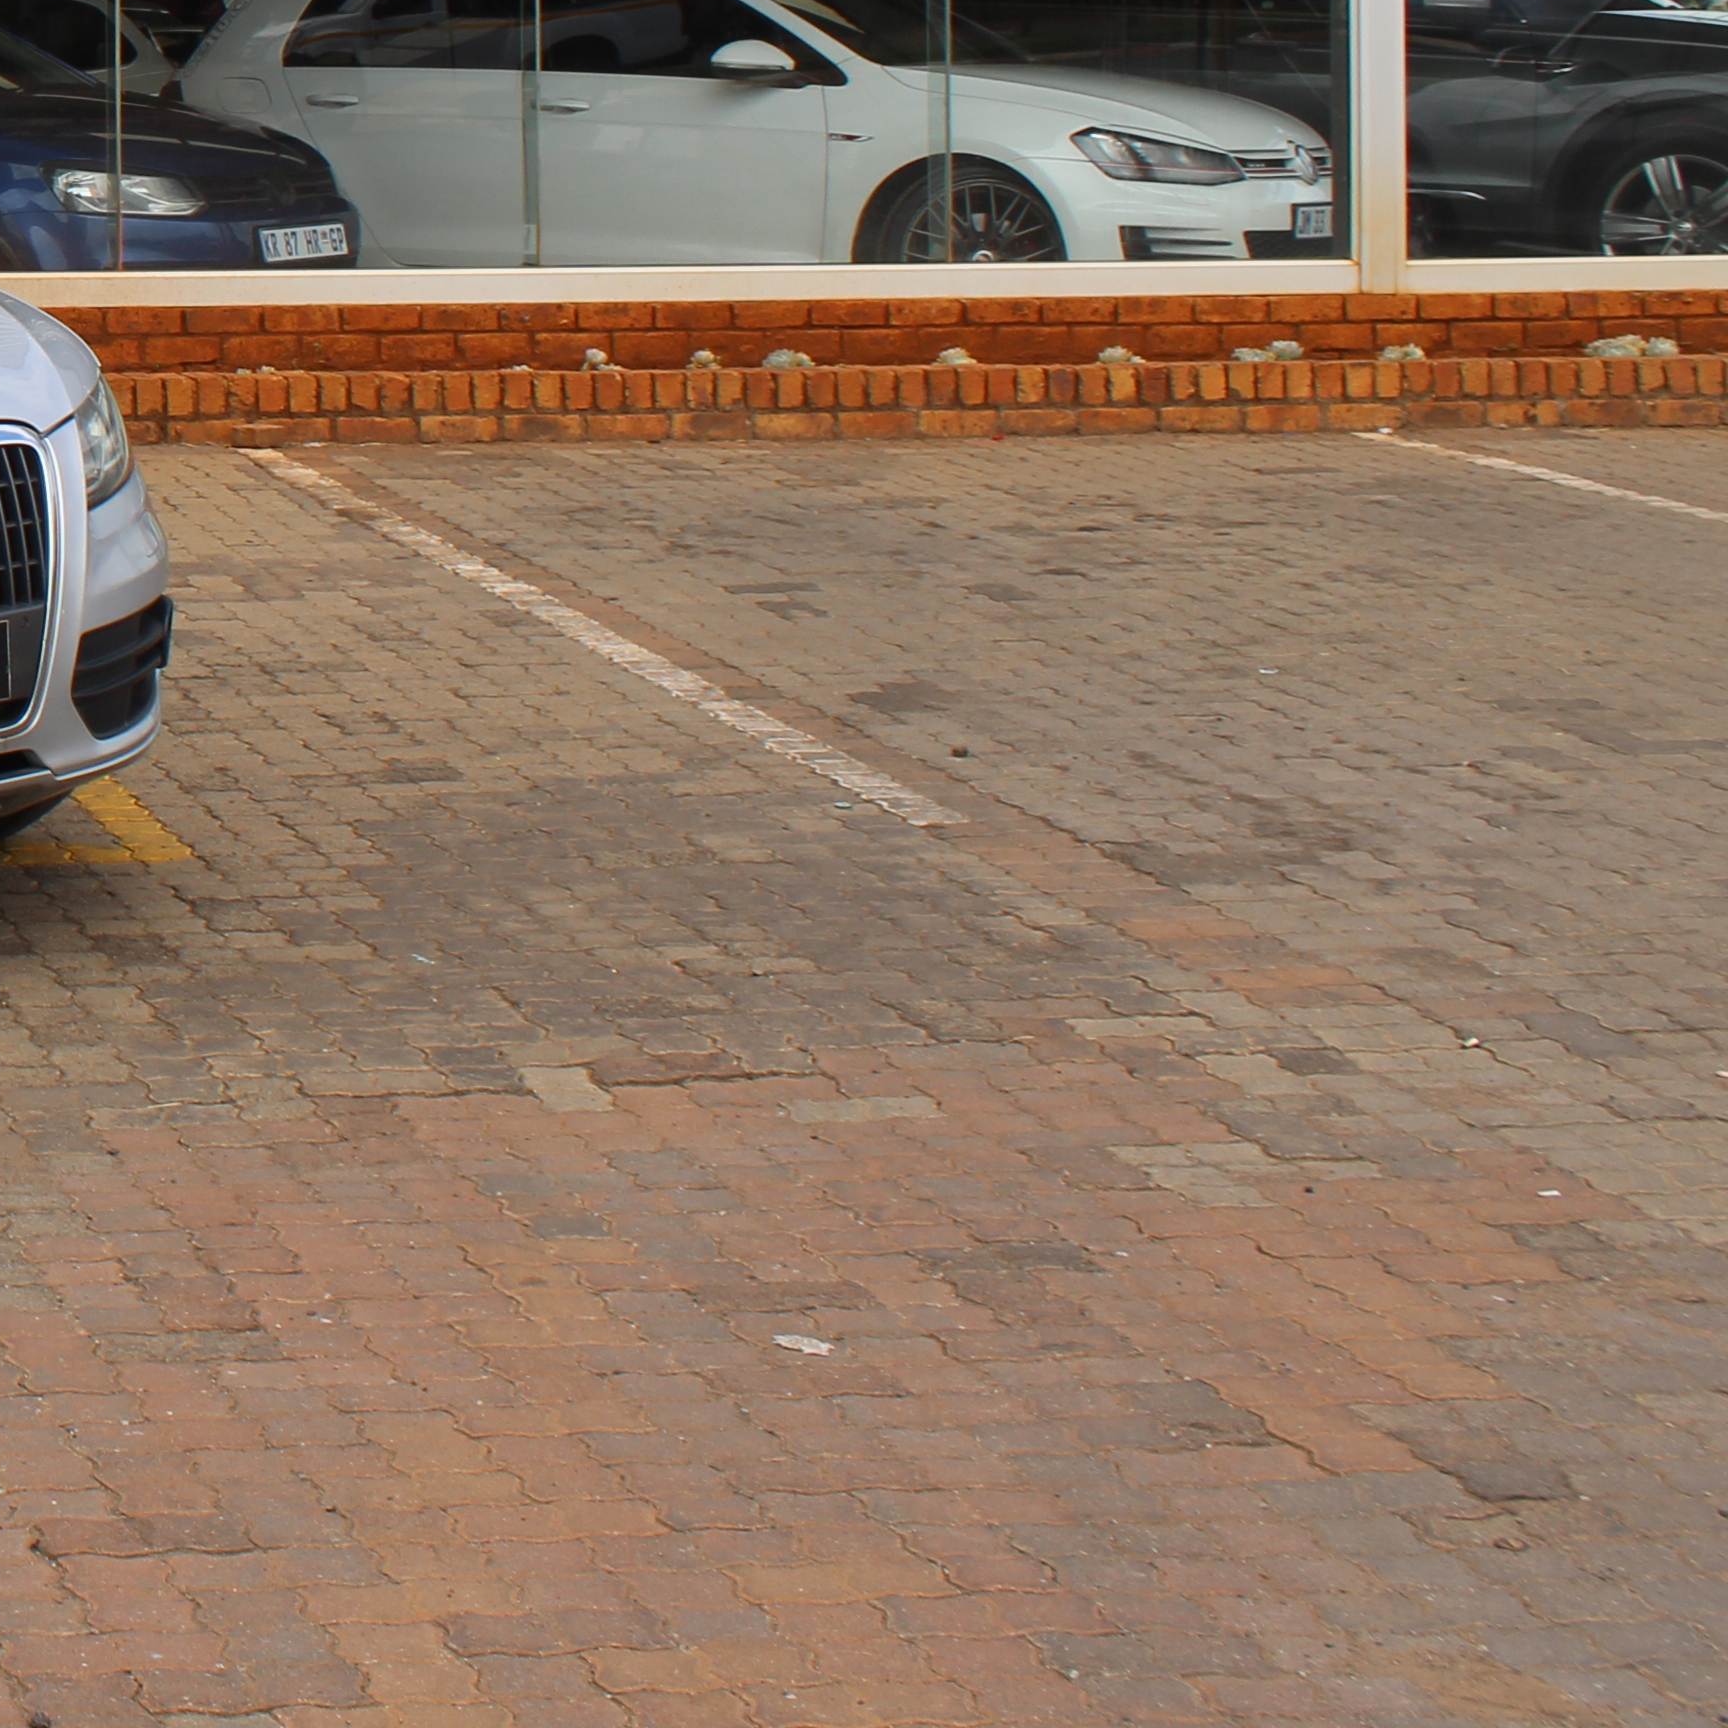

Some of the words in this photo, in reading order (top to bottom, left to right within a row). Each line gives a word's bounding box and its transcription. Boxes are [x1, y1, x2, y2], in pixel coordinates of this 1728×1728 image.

[262, 232, 281, 258] KR
[284, 231, 299, 257] 87
[304, 229, 323, 255] HR
[329, 227, 344, 252] GP
